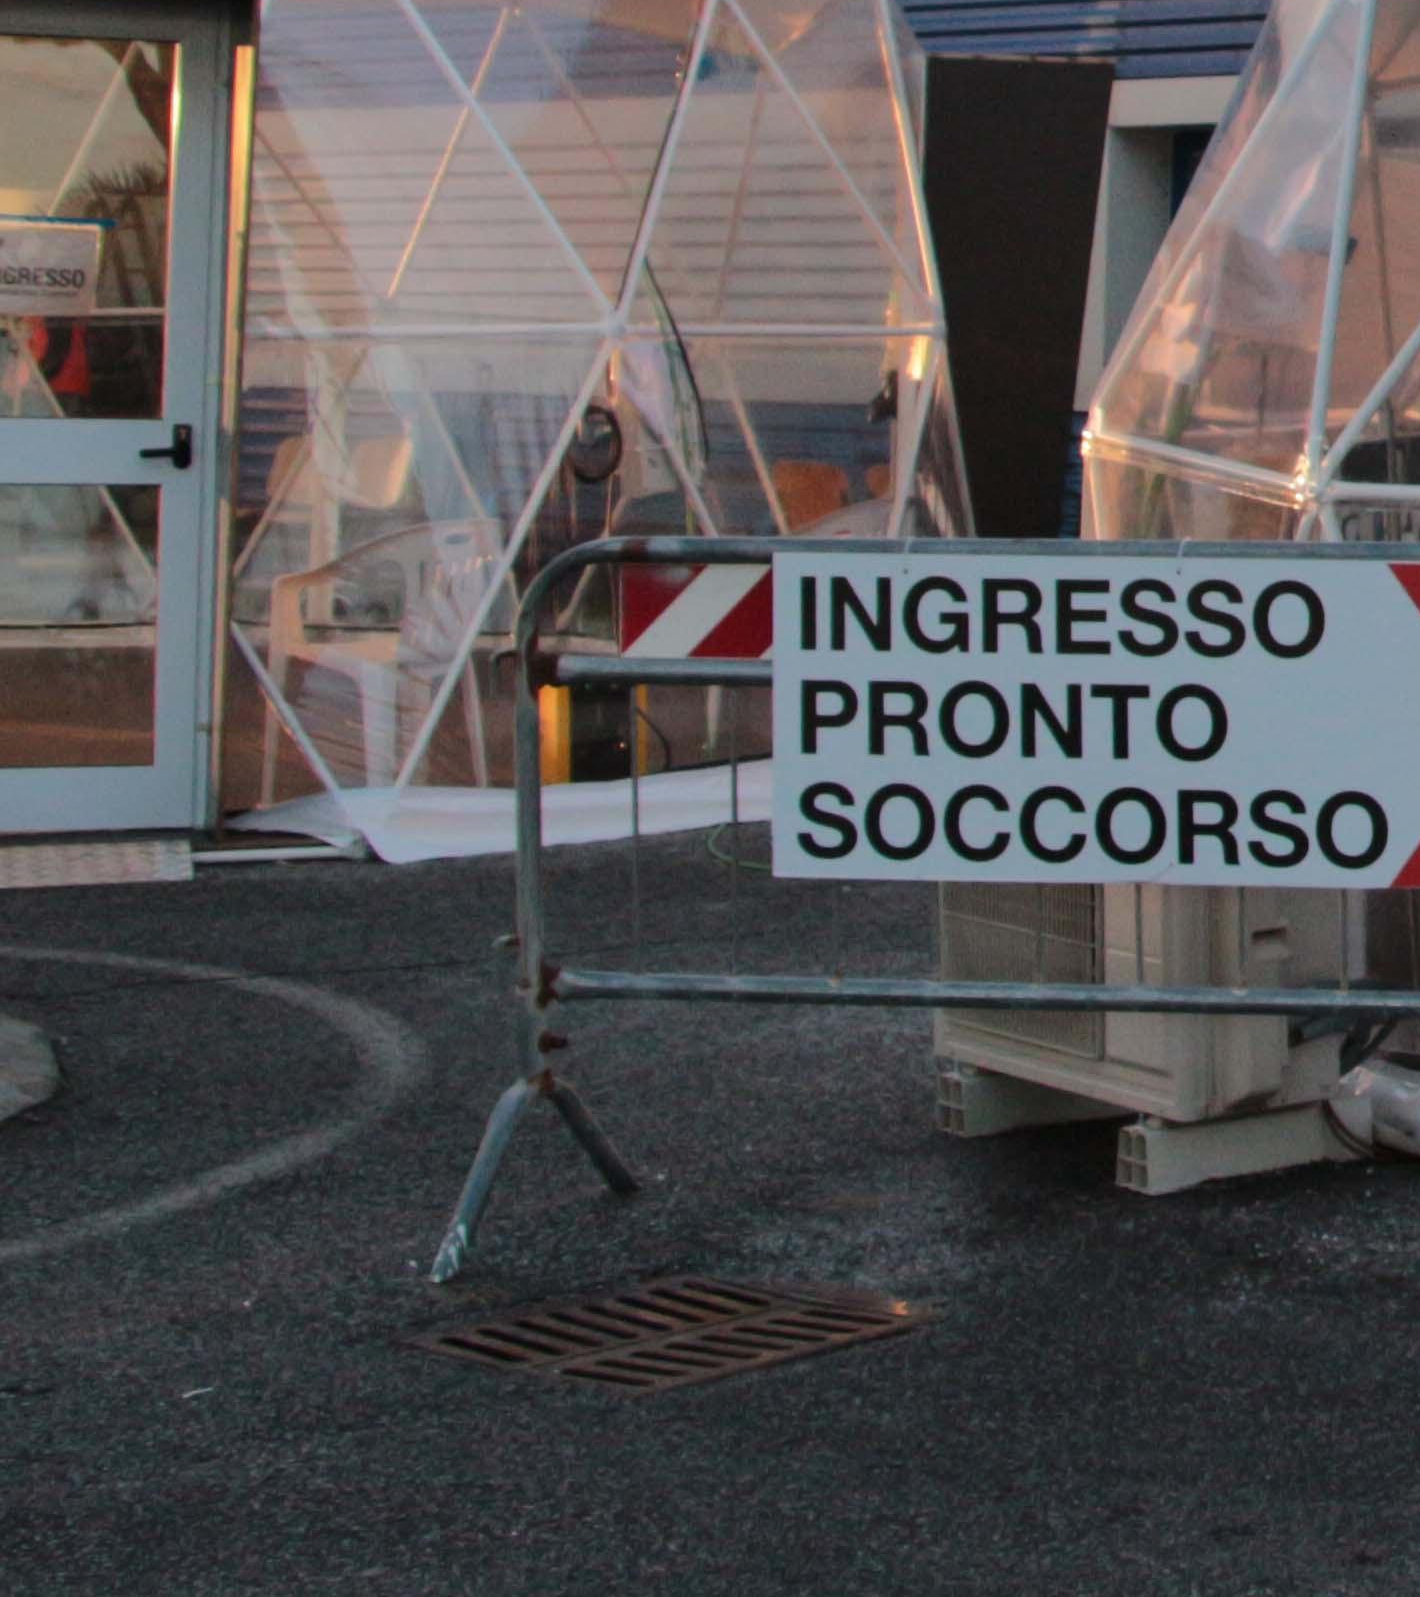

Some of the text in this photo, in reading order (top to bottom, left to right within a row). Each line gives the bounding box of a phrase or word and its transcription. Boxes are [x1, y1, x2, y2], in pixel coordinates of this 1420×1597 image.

[0, 266, 85, 289] GRESSO
[800, 576, 1326, 659] INGRESSO
[800, 679, 1228, 762] PRONTO
[797, 781, 1389, 870] SOCCORSO
